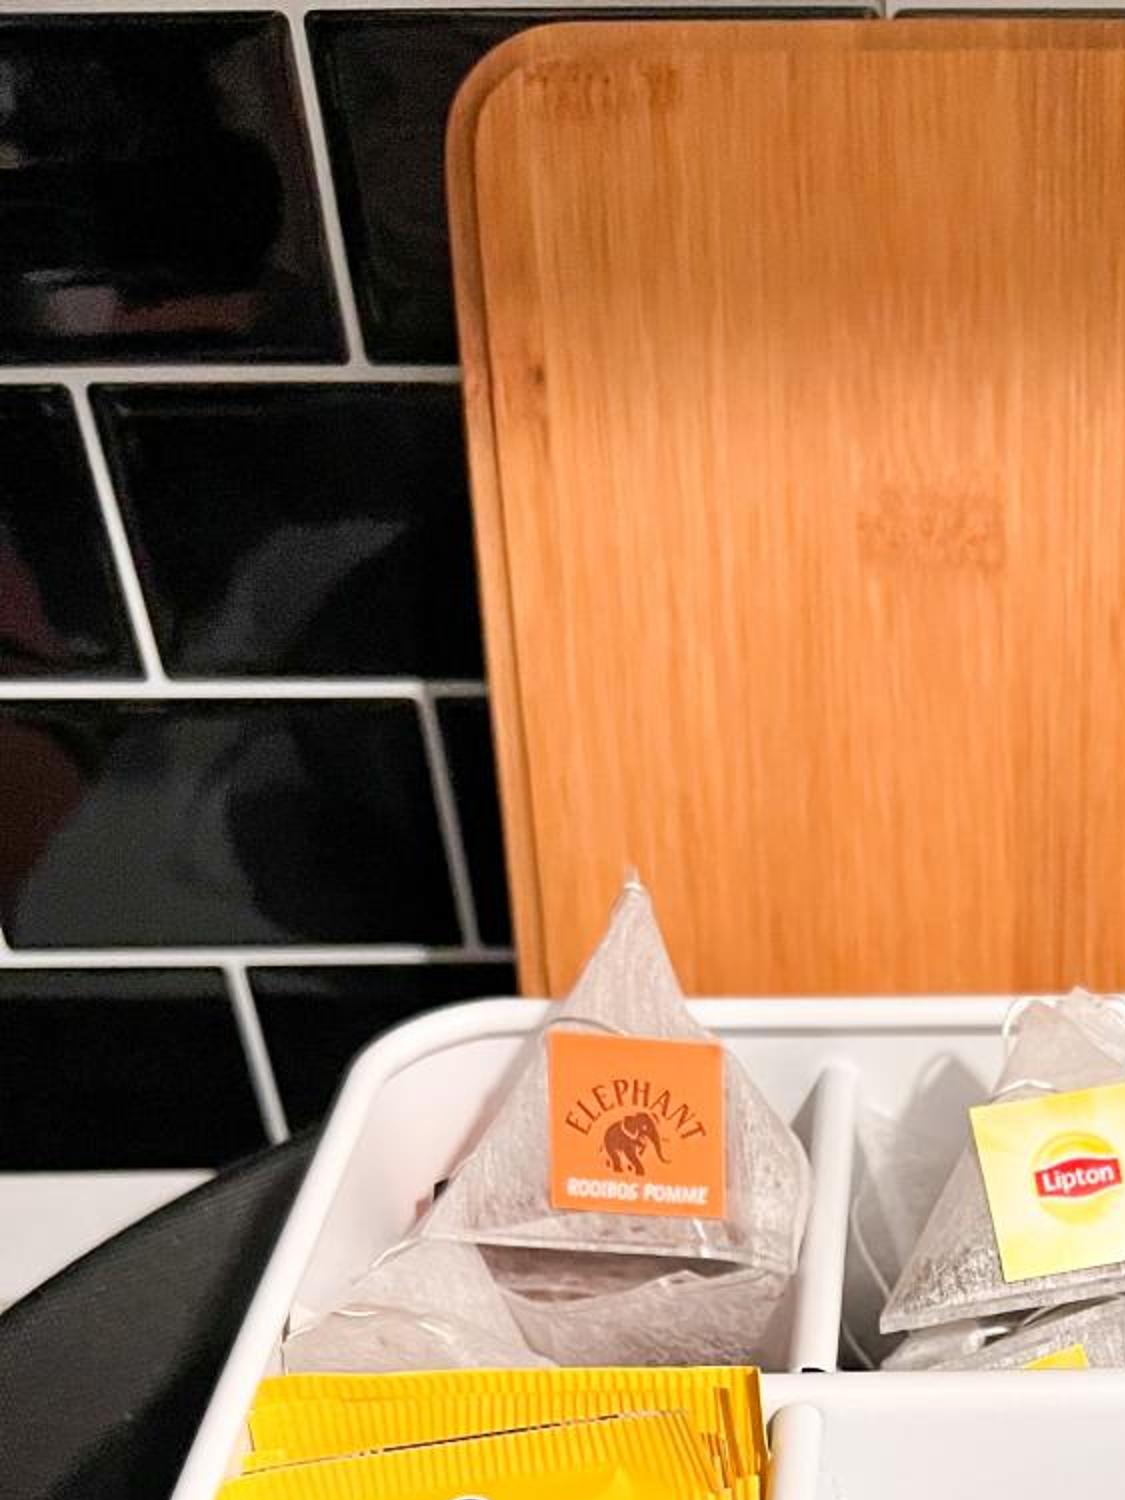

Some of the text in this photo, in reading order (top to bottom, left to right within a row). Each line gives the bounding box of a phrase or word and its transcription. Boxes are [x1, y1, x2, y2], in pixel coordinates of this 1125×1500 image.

[565, 1079, 707, 1139] ELEPHANT
[567, 1177, 708, 1204] ROOIBOS POMME
[1042, 1164, 1114, 1193] Lipton
